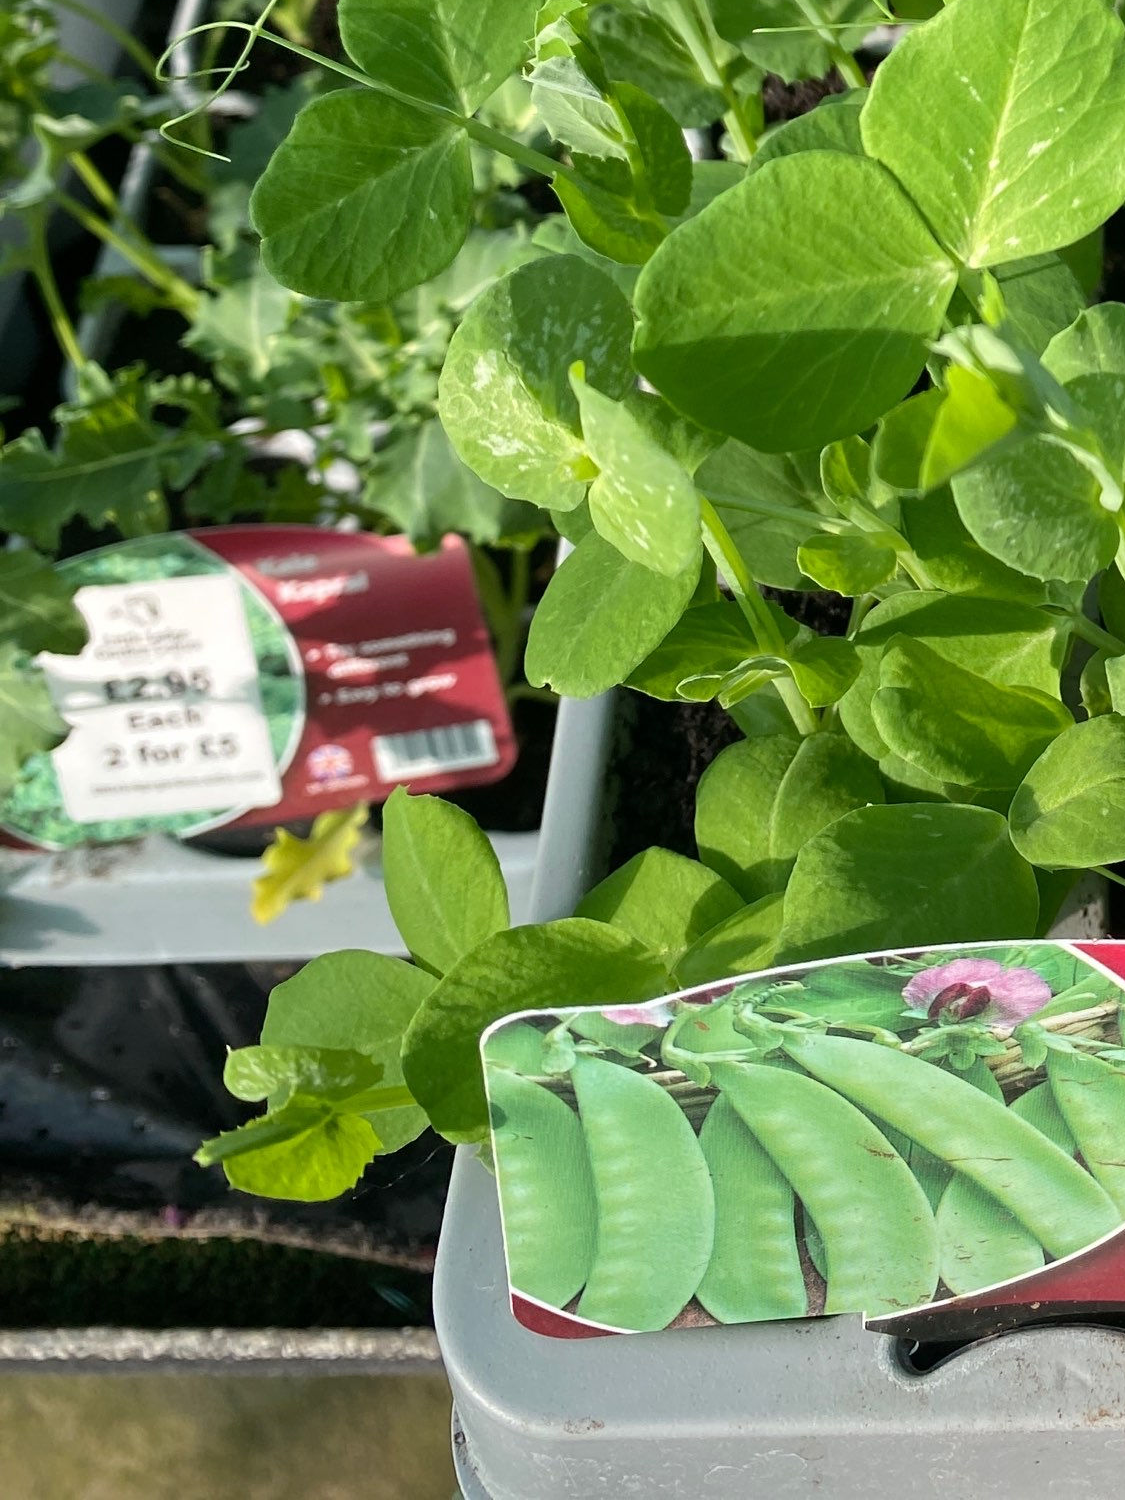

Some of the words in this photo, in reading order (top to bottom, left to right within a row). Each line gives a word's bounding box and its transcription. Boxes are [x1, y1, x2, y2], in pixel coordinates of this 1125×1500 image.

[128, 709, 202, 730] Each
[104, 746, 124, 767] 2
[138, 744, 184, 762] for
